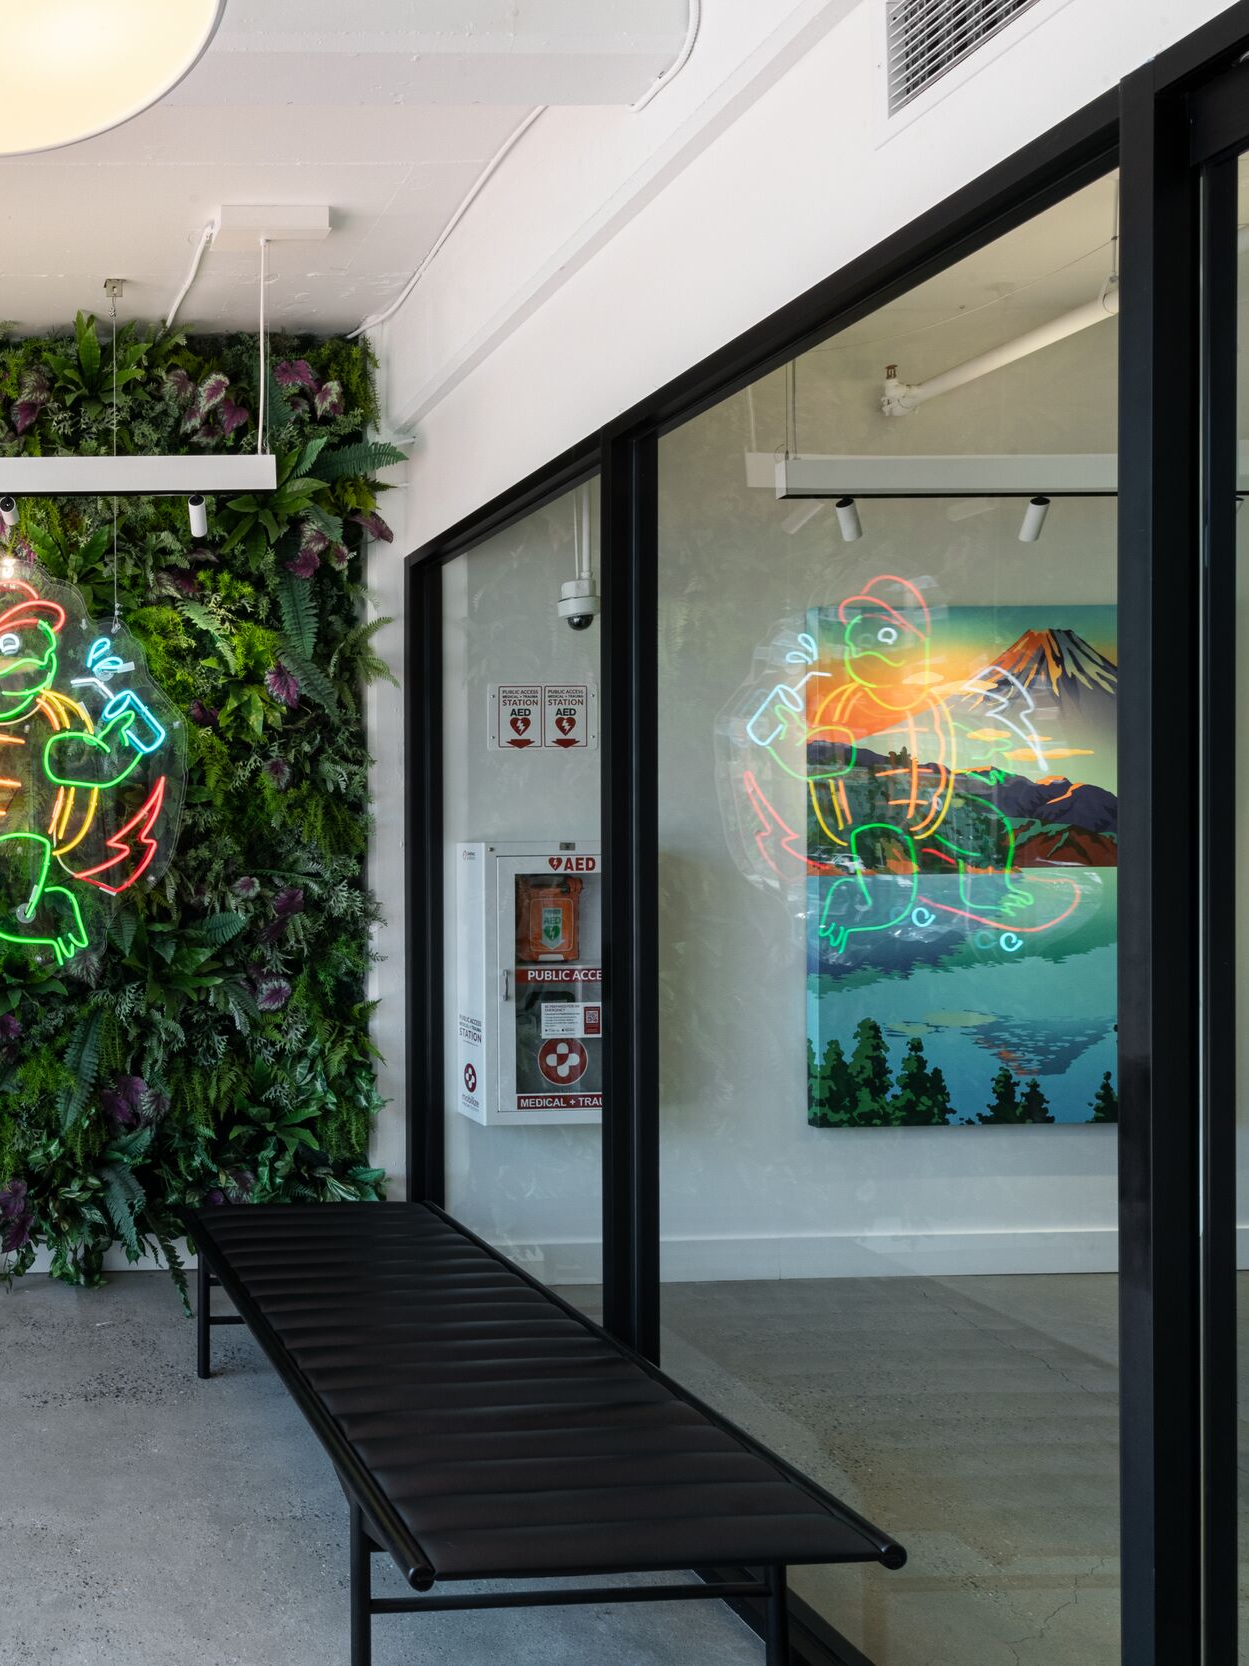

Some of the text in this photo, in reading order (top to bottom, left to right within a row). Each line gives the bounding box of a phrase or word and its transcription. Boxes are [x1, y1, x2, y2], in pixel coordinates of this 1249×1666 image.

[502, 699, 539, 707] STATION
[510, 708, 531, 717] AED
[555, 708, 577, 716] AED
[563, 857, 596, 872] AED
[543, 916, 562, 926] AED
[527, 970, 570, 981] PUBLIC
[459, 1027, 482, 1043] STATION
[520, 1097, 567, 1108] MEDICAL
